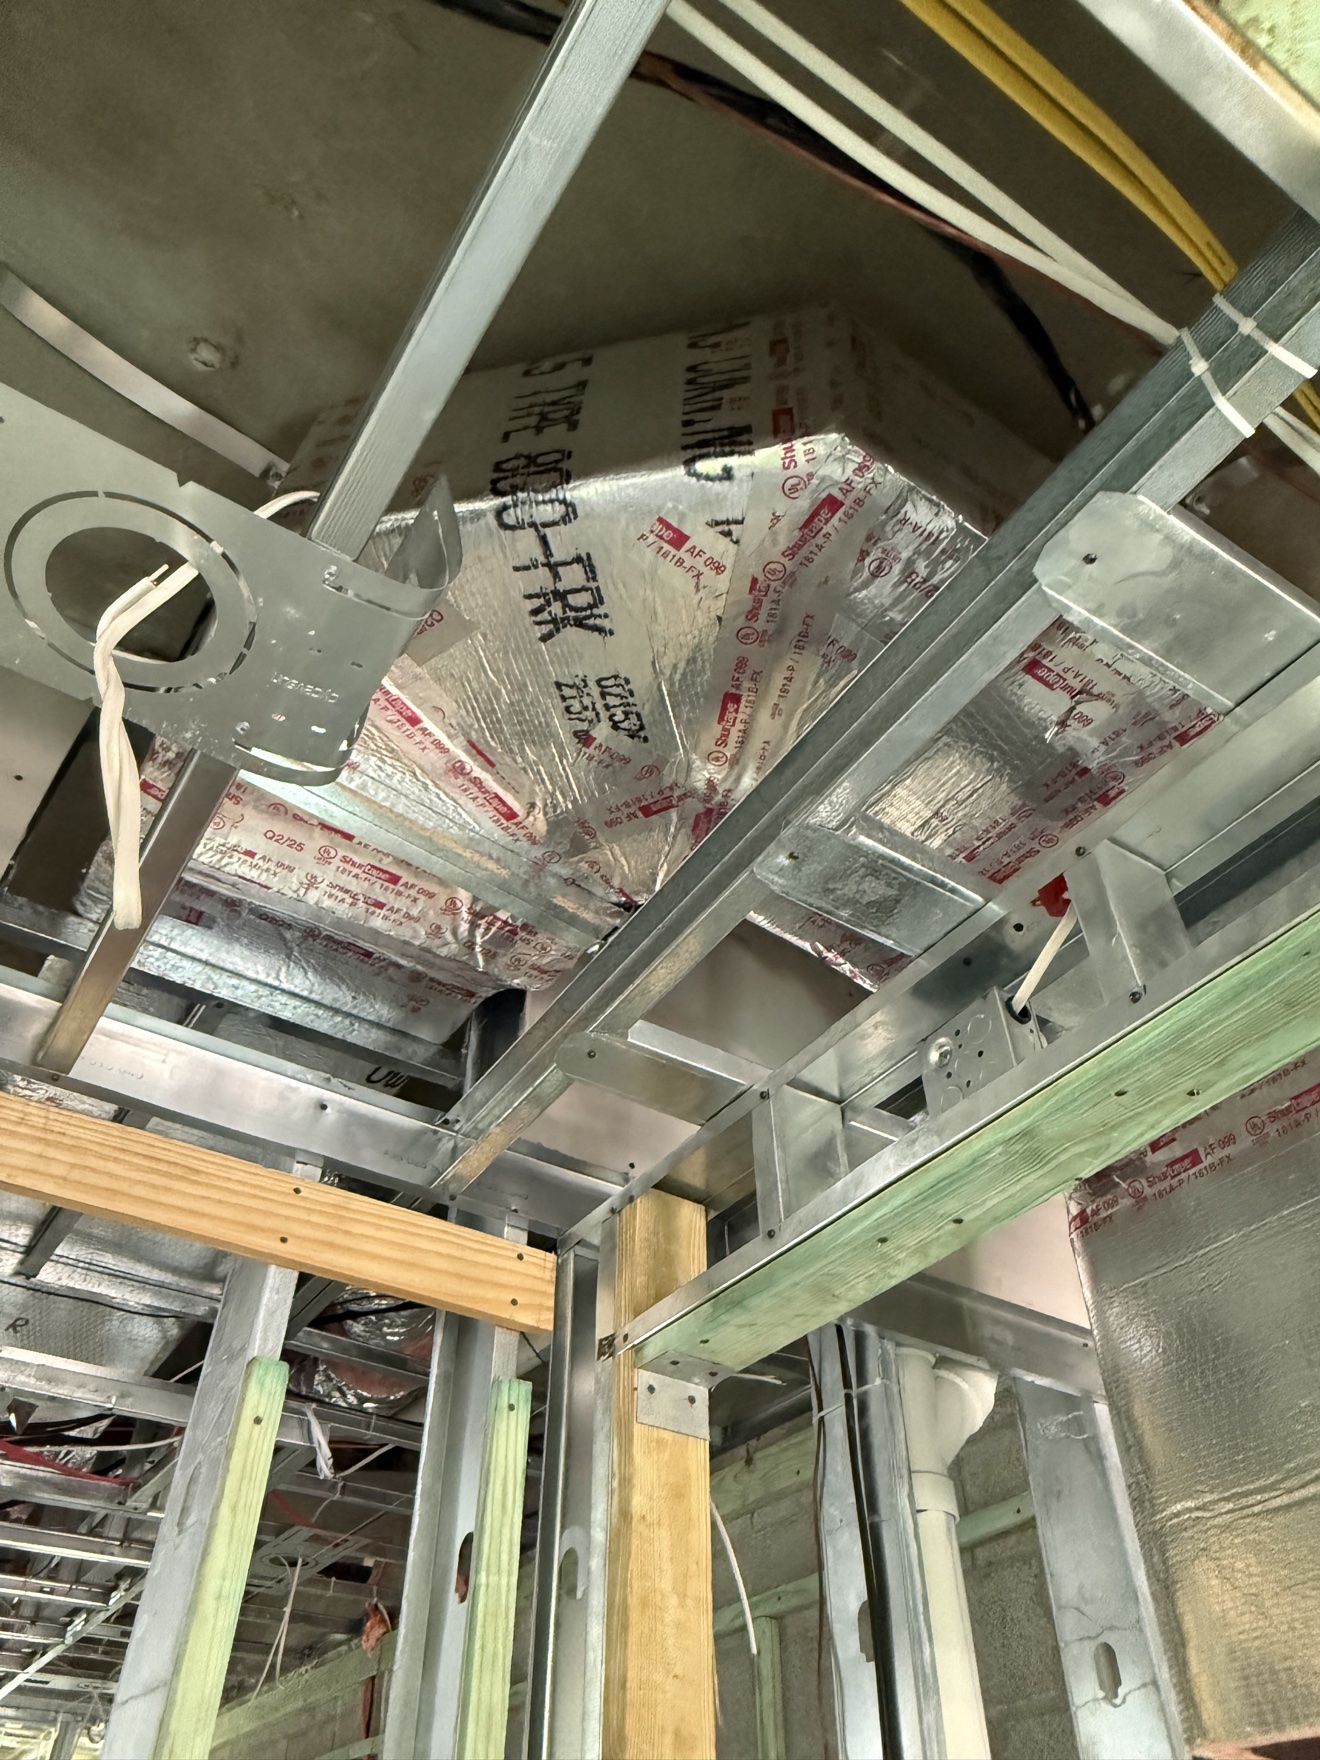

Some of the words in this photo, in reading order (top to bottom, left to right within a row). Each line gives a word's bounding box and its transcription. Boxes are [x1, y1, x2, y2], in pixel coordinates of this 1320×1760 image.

[838, 480, 854, 499] AF
[839, 476, 882, 525] 181B-FX
[685, 544, 705, 566] AF
[704, 556, 727, 576] 099
[417, 724, 433, 739] AF
[512, 820, 527, 832] AF
[263, 829, 306, 852] Q2/25
[339, 854, 390, 881] Shurtape
[400, 880, 418, 892] AF
[418, 887, 438, 901] 099
[1203, 1143, 1218, 1160] AF
[1218, 1133, 1236, 1151] 099
[1192, 1153, 1234, 1180] 181B-FX
